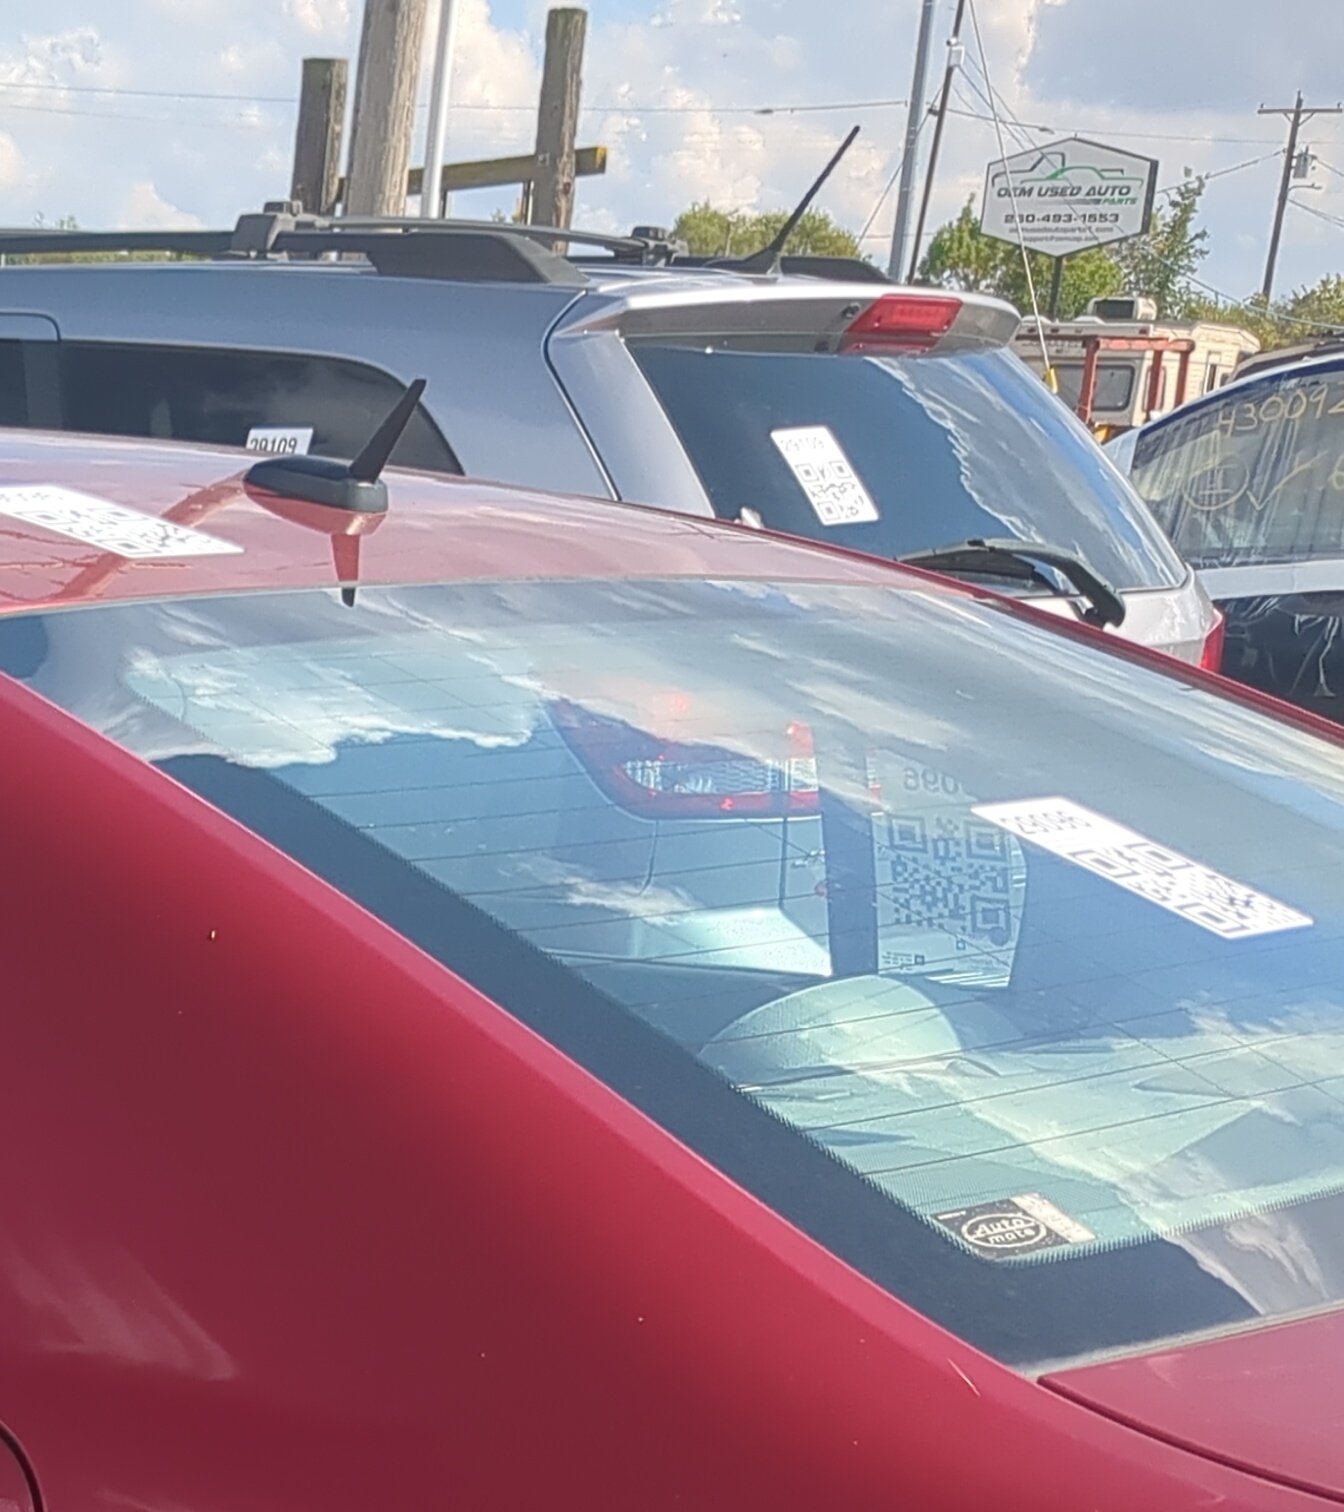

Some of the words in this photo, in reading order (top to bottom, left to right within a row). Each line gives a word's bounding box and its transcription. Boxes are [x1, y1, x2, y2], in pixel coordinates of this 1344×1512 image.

[1037, 186, 1082, 197] USED
[1085, 186, 1131, 196] AUTO
[974, 1217, 1026, 1237] Auto
[986, 1226, 1036, 1245] mate
